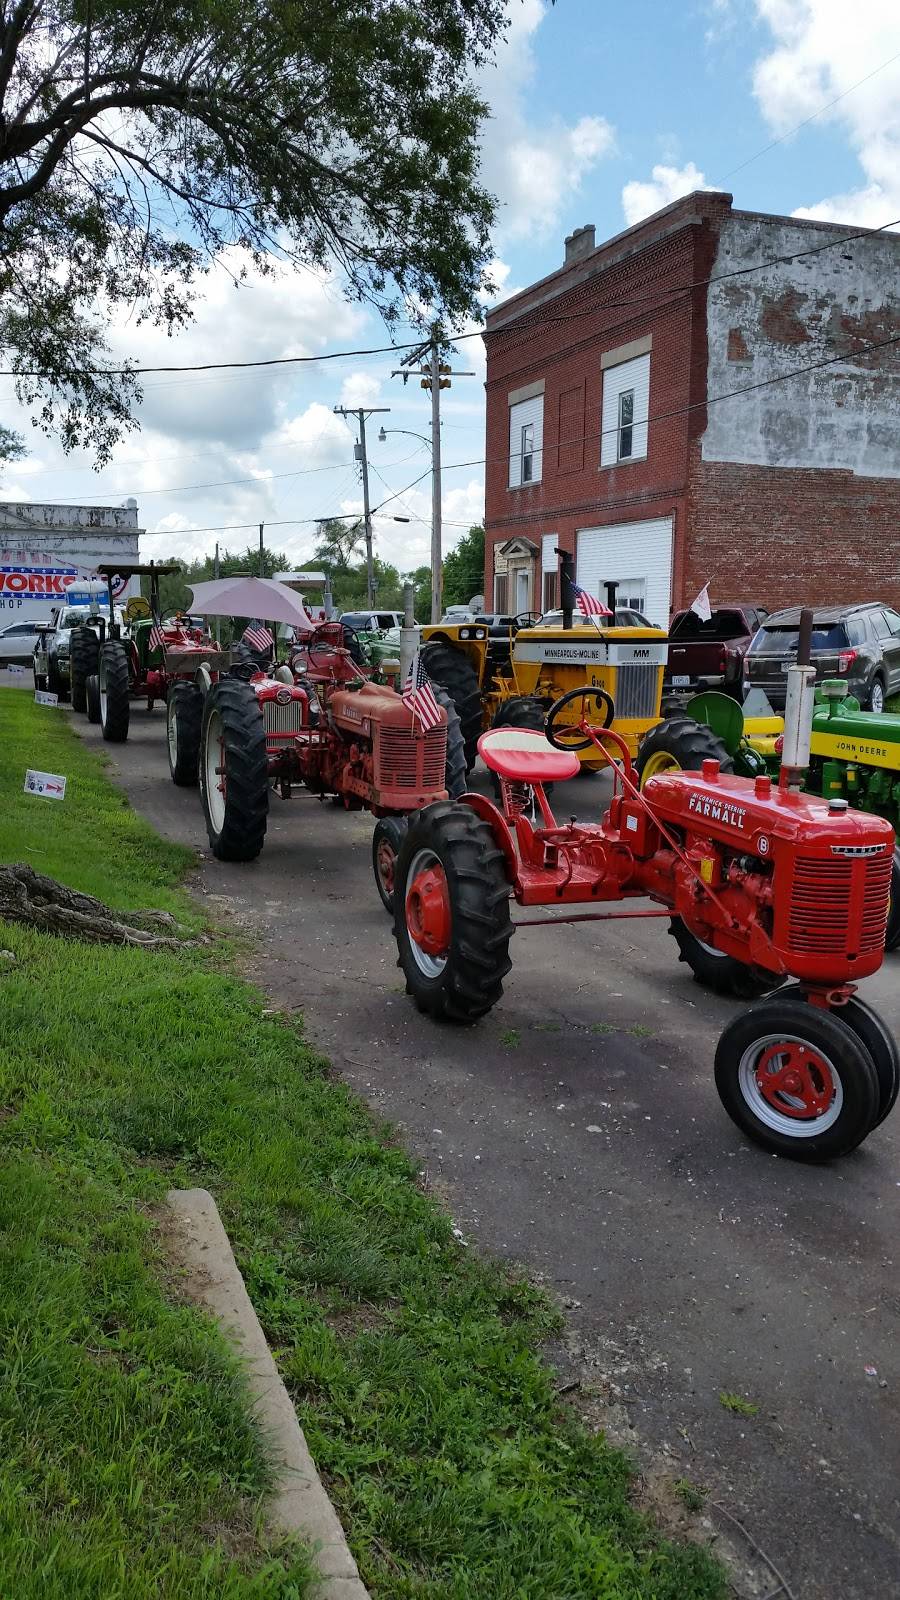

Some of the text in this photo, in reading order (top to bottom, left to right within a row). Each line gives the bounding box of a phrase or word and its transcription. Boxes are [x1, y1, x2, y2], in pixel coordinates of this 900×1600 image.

[544, 649, 599, 659] MINNEAPOLIS-MOLINE
[633, 649, 650, 658] MM
[836, 742, 887, 757] JOHN DEERE
[688, 798, 744, 829] FARMALL
